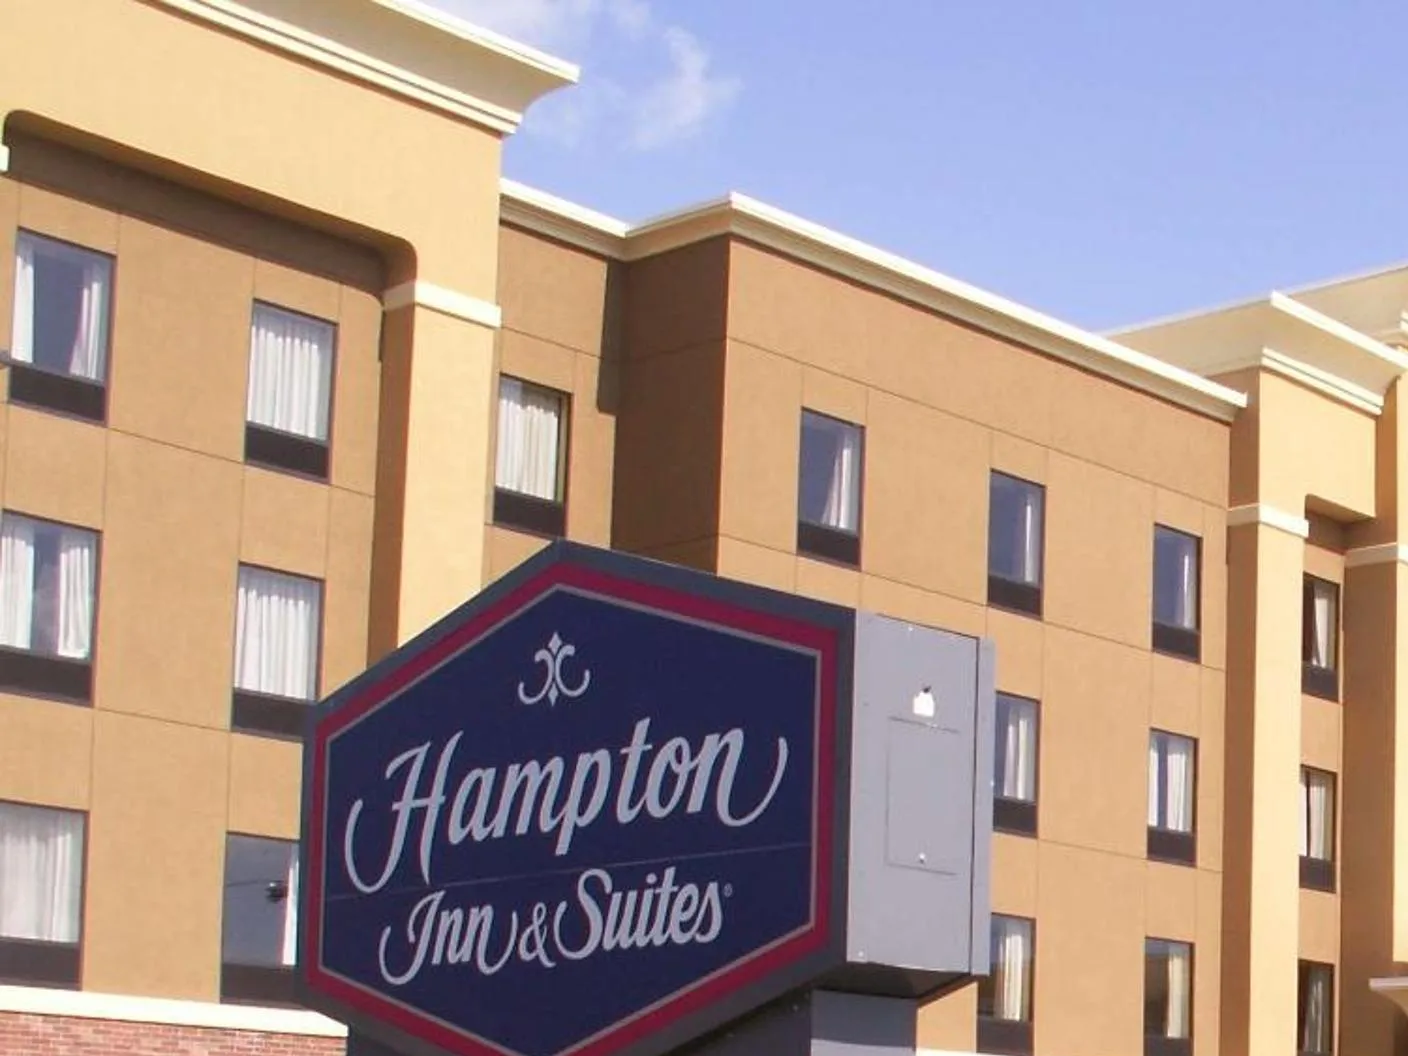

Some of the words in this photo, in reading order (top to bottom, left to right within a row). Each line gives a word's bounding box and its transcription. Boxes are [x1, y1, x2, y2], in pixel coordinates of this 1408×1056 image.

[344, 717, 788, 893] Hampton
[379, 890, 518, 985] Inn
[519, 902, 555, 968] &
